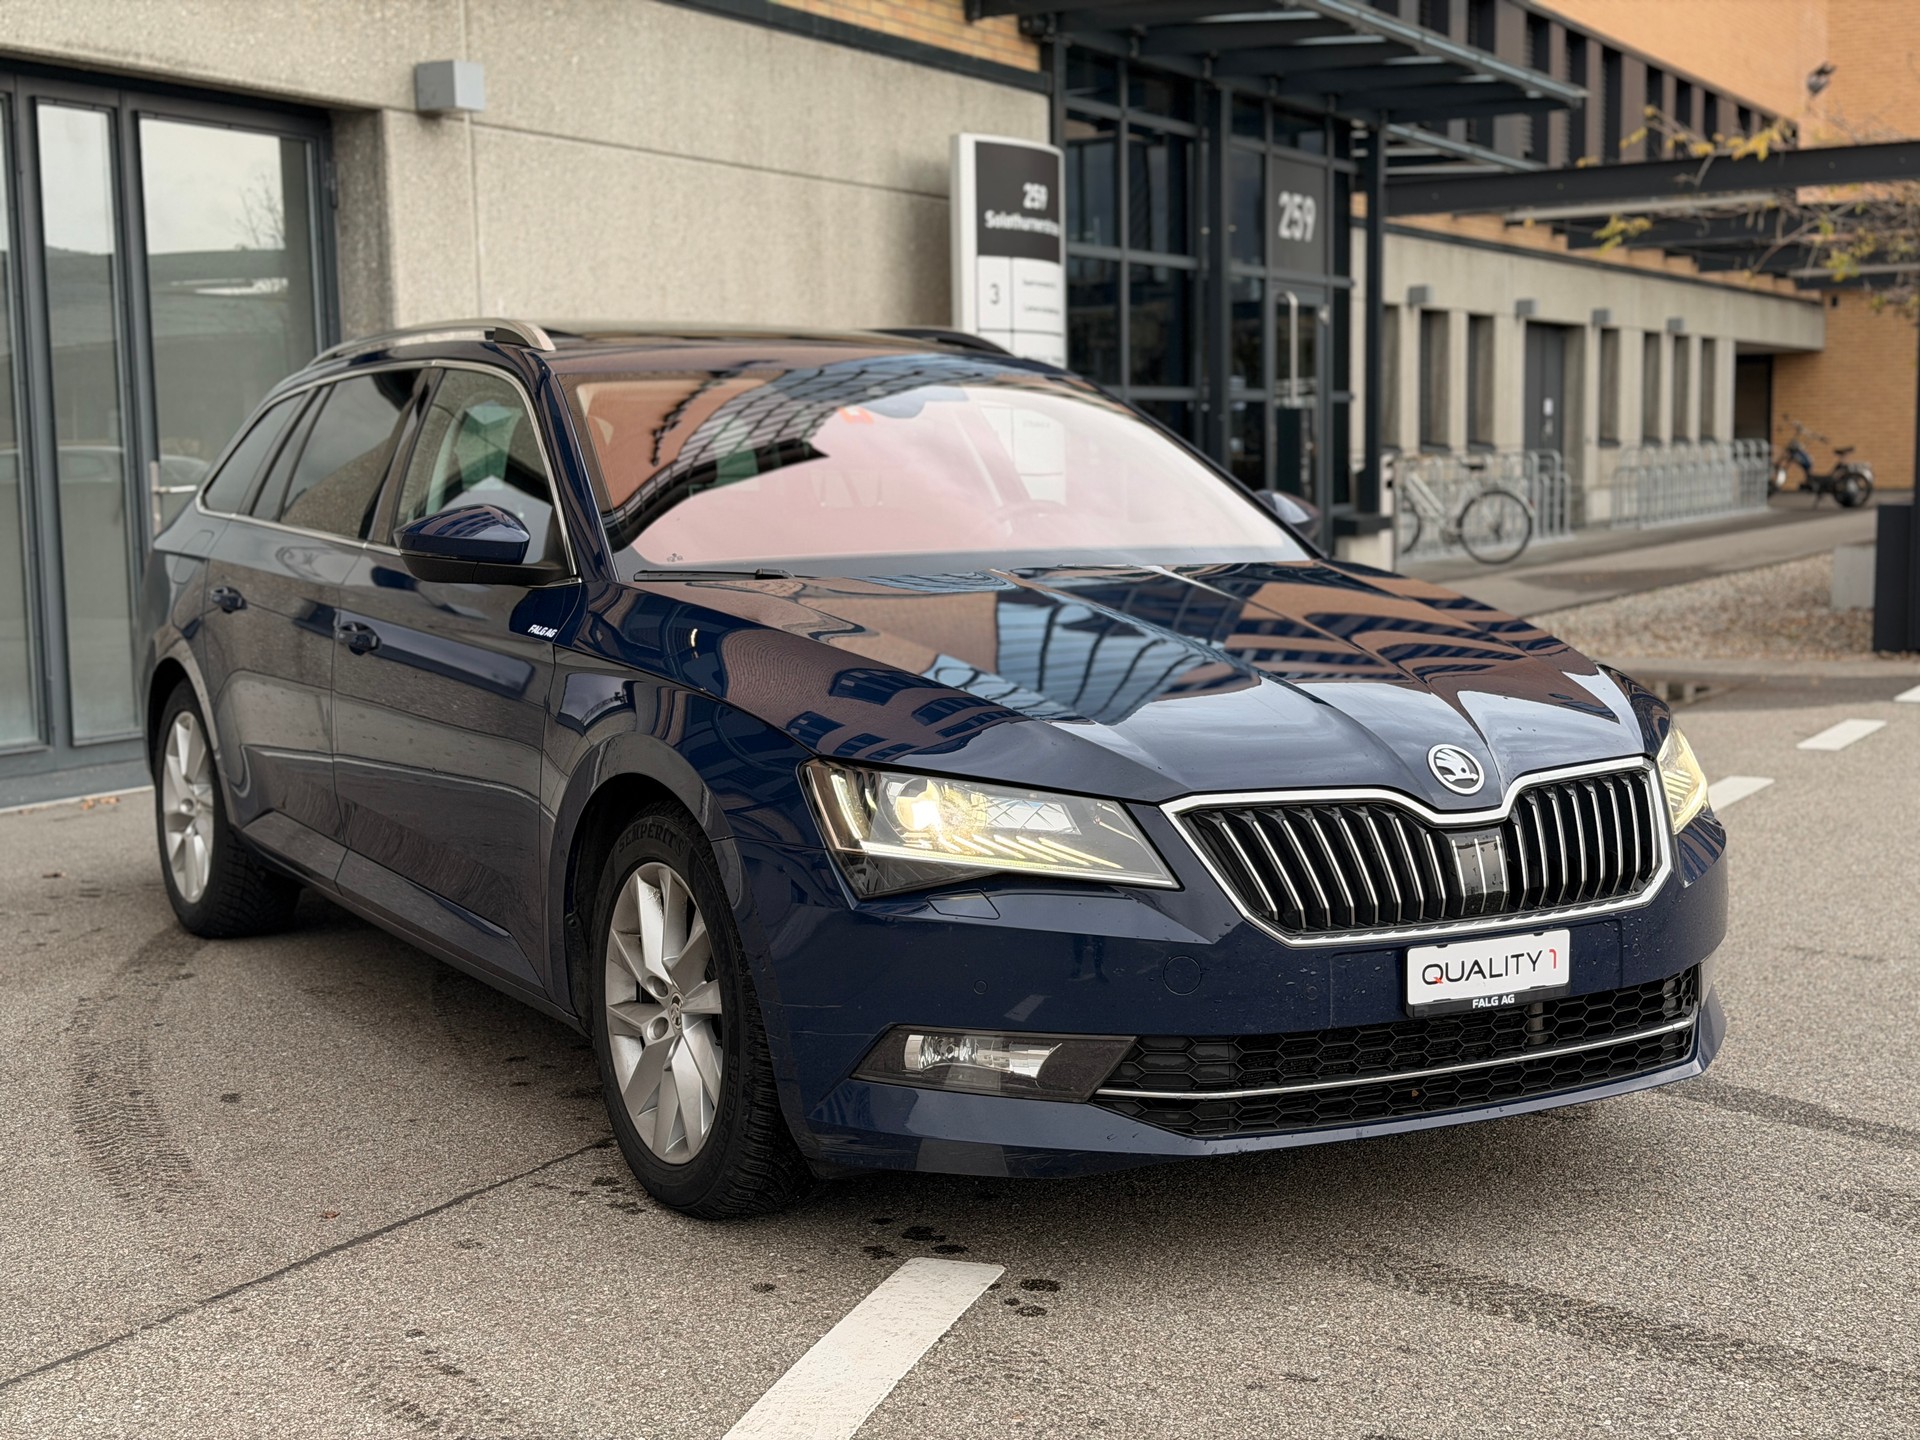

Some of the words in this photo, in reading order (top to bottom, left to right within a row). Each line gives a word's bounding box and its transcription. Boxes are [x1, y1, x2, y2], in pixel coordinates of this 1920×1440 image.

[1023, 182, 1048, 211] 259
[1278, 191, 1316, 242] 259
[990, 282, 1000, 305] 3
[528, 624, 548, 636] FALG
[544, 628, 558, 638] AG
[618, 822, 677, 853] SEMPERIT
[1422, 950, 1542, 985] QUALITY
[1549, 949, 1557, 969] 1
[1472, 995, 1499, 1009] FALG
[1501, 994, 1515, 1005] AG
